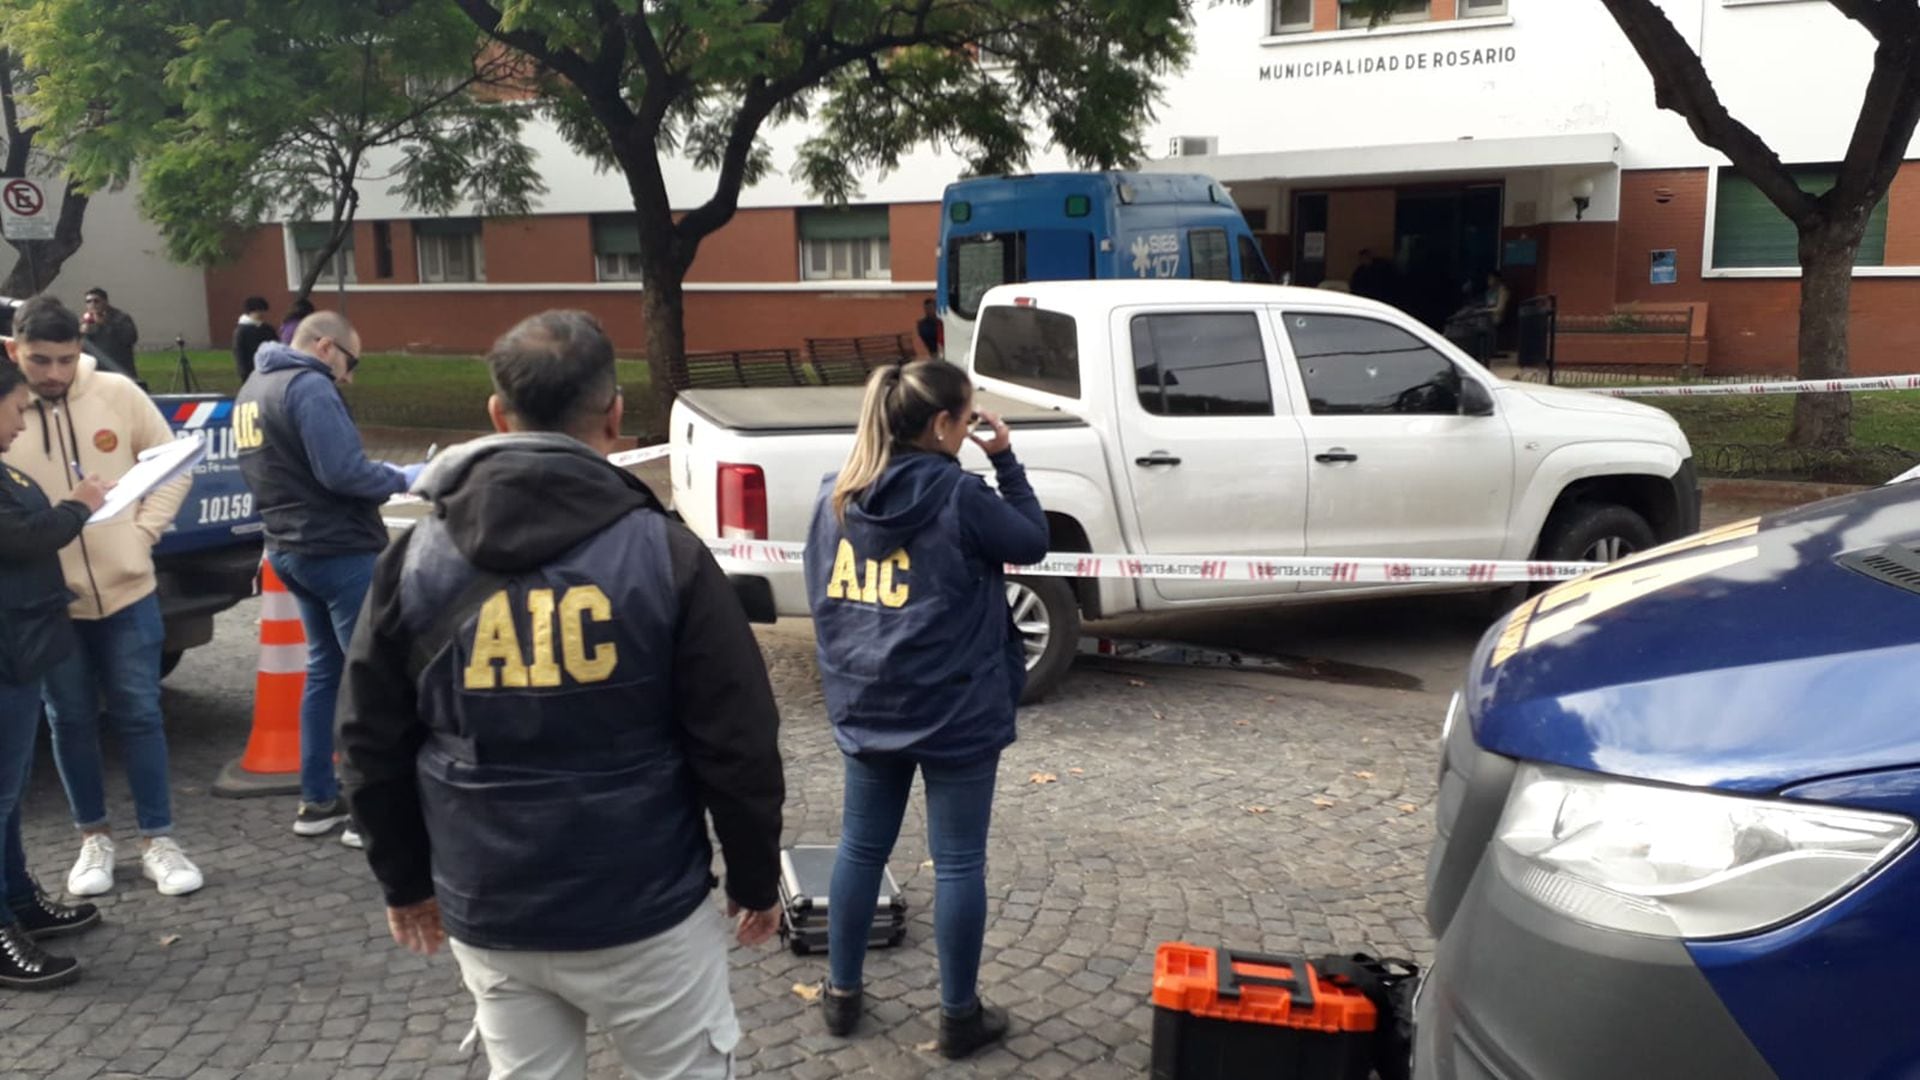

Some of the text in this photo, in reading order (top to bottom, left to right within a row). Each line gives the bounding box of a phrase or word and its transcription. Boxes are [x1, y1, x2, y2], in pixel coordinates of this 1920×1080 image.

[1259, 46, 1516, 81] MUNICIPALIDAD DE ROSARIO
[1151, 254, 1180, 278] 107
[198, 493, 252, 523] 10159
[826, 537, 910, 608] AIC
[464, 584, 618, 689] AIC
